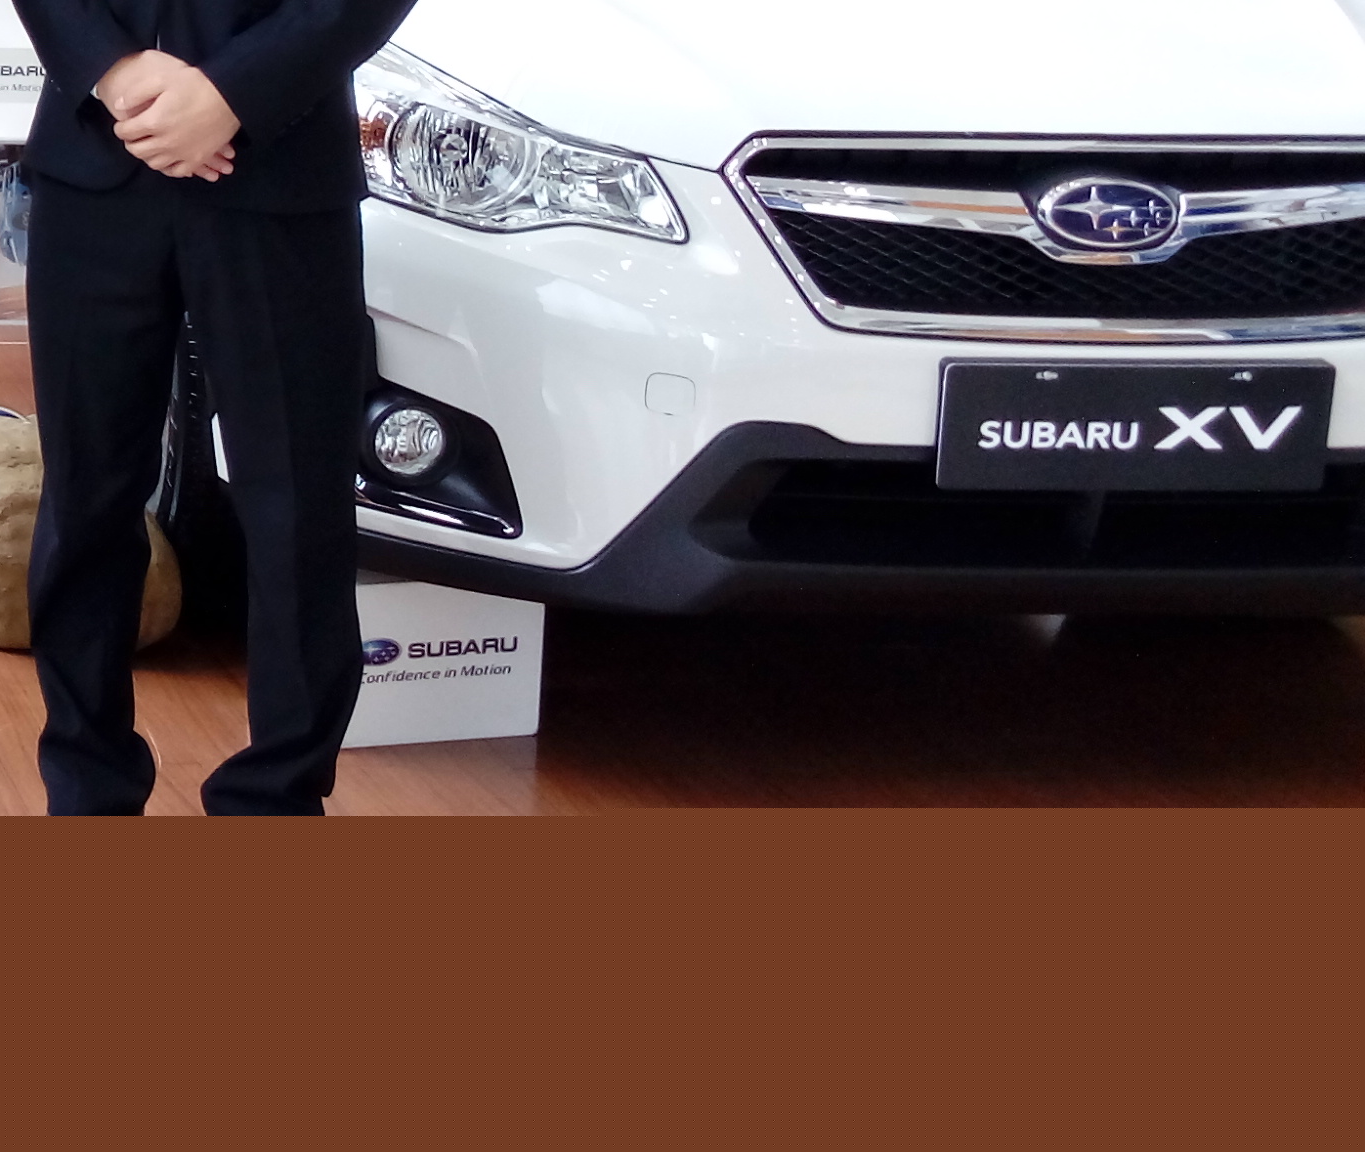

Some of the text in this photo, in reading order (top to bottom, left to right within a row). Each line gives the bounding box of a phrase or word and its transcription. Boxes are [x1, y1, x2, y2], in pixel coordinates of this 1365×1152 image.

[978, 406, 1302, 450] SUBARU XV
[408, 636, 518, 659] SUBARU
[444, 668, 457, 679] in
[460, 665, 512, 677] Motion
